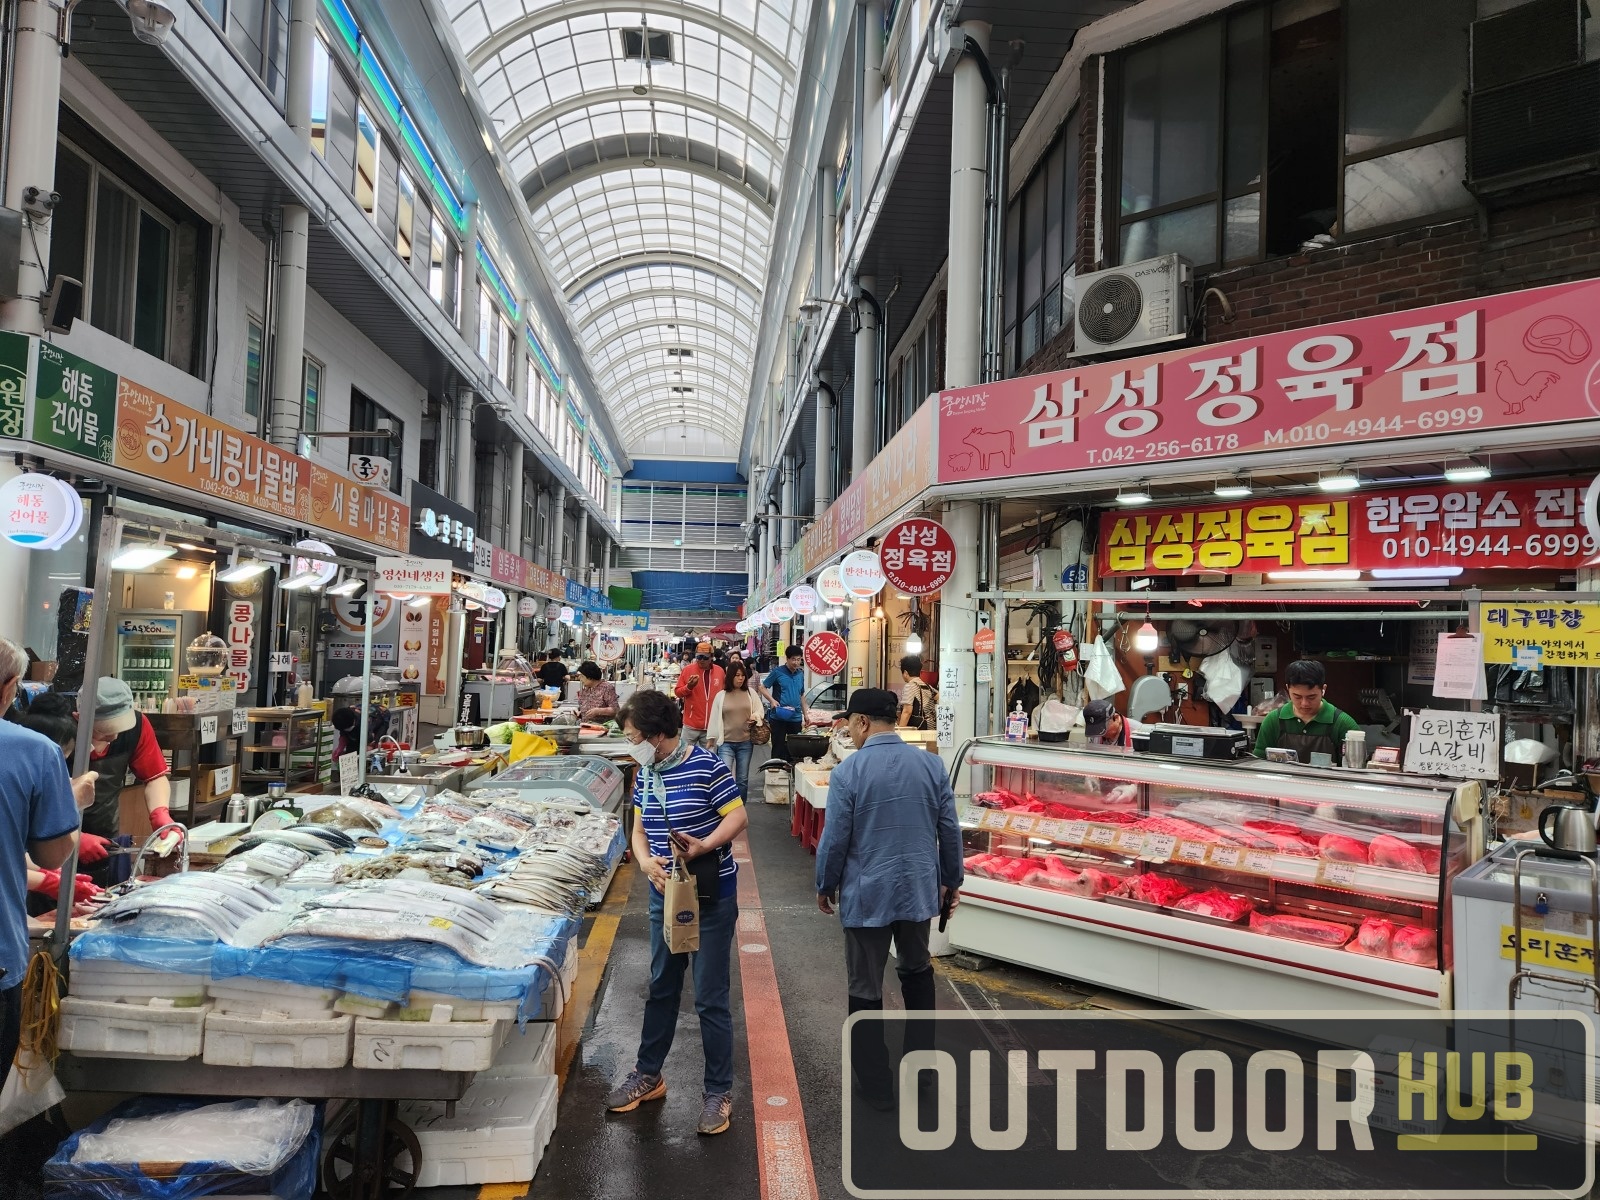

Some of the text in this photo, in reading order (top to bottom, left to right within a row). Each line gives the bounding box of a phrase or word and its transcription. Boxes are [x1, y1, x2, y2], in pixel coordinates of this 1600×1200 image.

[62, 367, 94, 408] 해동
[1020, 309, 1488, 448] 삼성정육점
[118, 381, 155, 412] 중앙시장
[941, 391, 990, 417] 중앙시장
[50, 400, 99, 447] 건어물
[1264, 405, 1484, 446] M.010-4944-6999
[144, 403, 299, 506] 송가네콩나물밥
[1087, 433, 1240, 464] T.042-256-6178
[358, 456, 374, 479] 죽
[17, 494, 44, 508] 해동
[330, 482, 401, 541] 서울마님죽
[1366, 487, 1588, 533] 한우암소 전
[9, 509, 49, 525] 건어물
[898, 525, 938, 547] 삼성
[1108, 500, 1350, 572] 삼성정육점
[1382, 533, 1595, 560] 010-4944-6999
[883, 548, 952, 573] 정육점
[382, 568, 446, 583] 영선네생선
[1487, 607, 1586, 629] 대구막창
[229, 604, 252, 690] 콩나물밥
[808, 636, 846, 672] 협신닭집
[1541, 639, 1586, 650] 야외에서
[1545, 649, 1589, 660] 간편하게
[1418, 718, 1496, 743] 오리훈제
[1419, 741, 1485, 764] LA갈비
